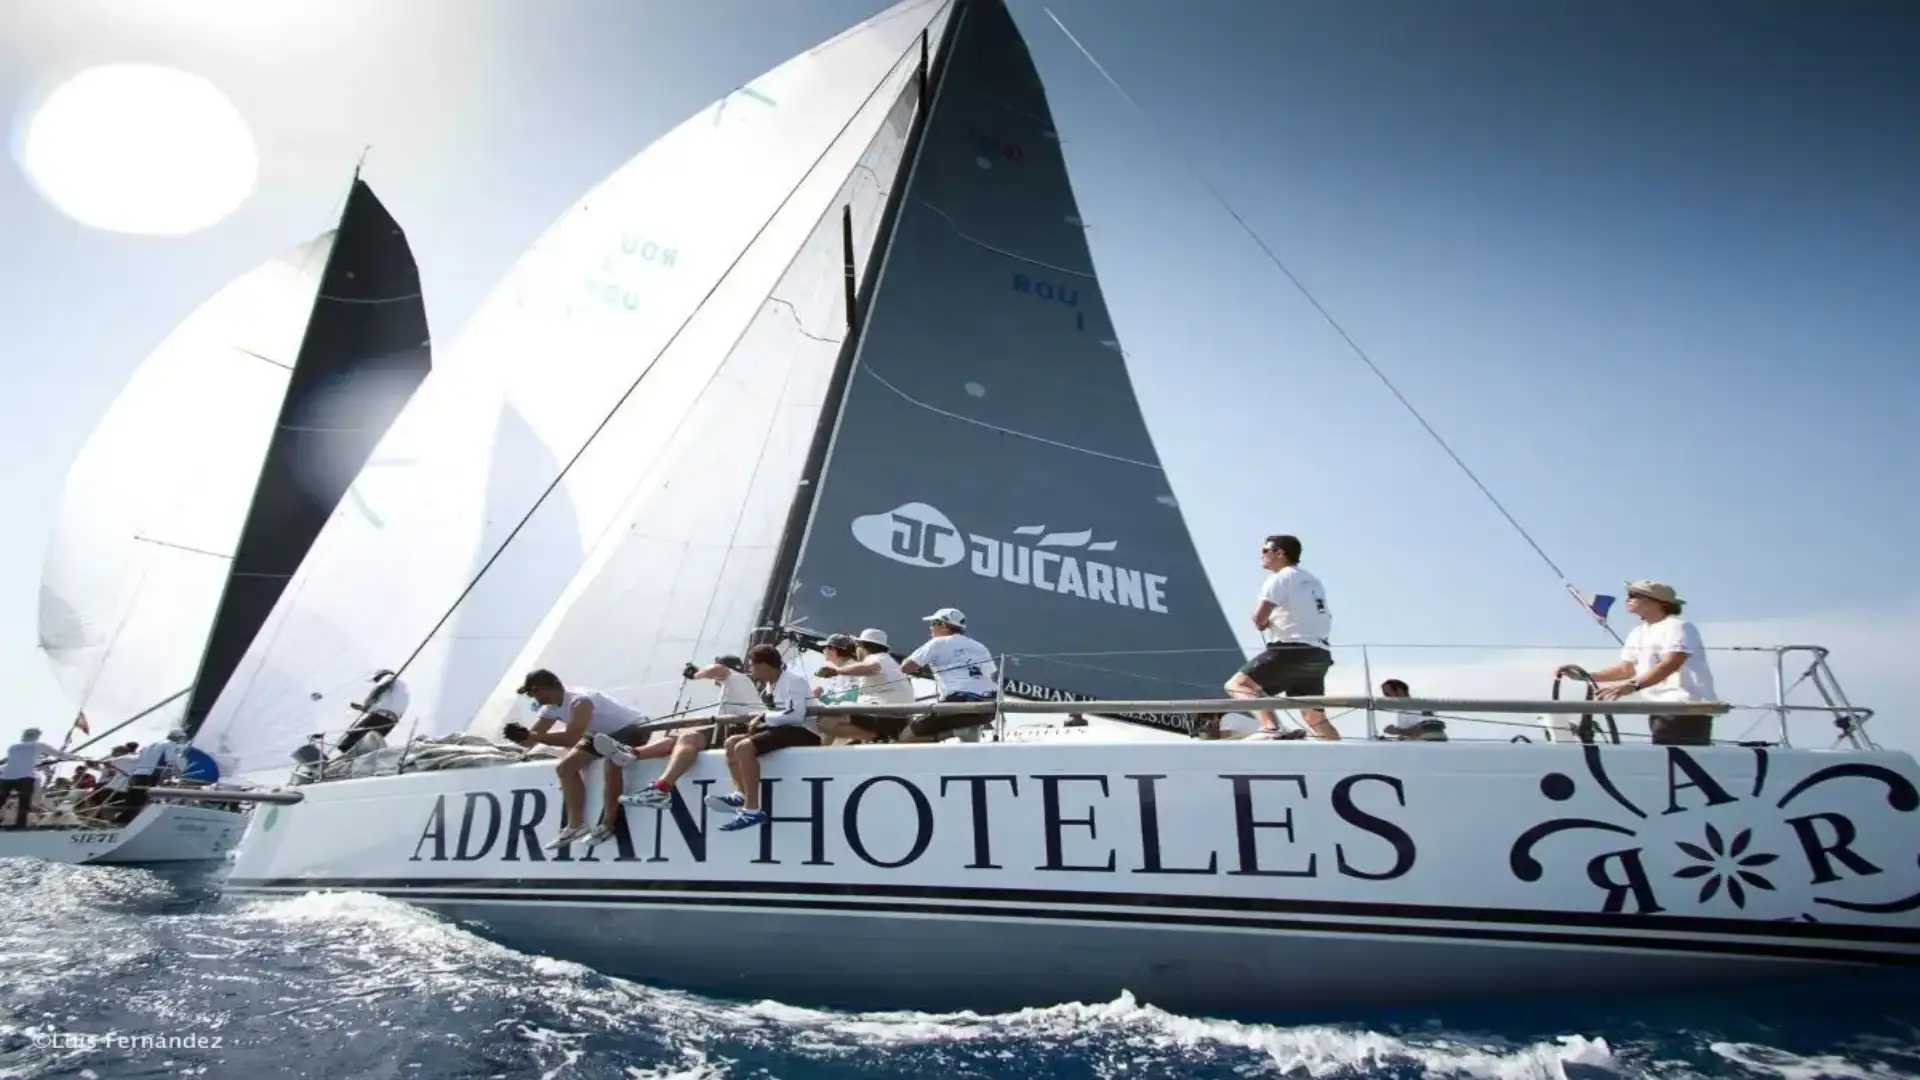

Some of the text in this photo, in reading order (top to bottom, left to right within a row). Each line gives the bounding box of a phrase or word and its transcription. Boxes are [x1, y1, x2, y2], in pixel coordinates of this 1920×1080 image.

[969, 532, 1169, 614] JUCARNE
[1005, 679, 1077, 703] ADRIAN
[1660, 746, 1739, 816] A
[69, 832, 119, 845] SIE7E
[409, 774, 1417, 880] ADRIAN HOTELES
[1784, 812, 1883, 885] R
